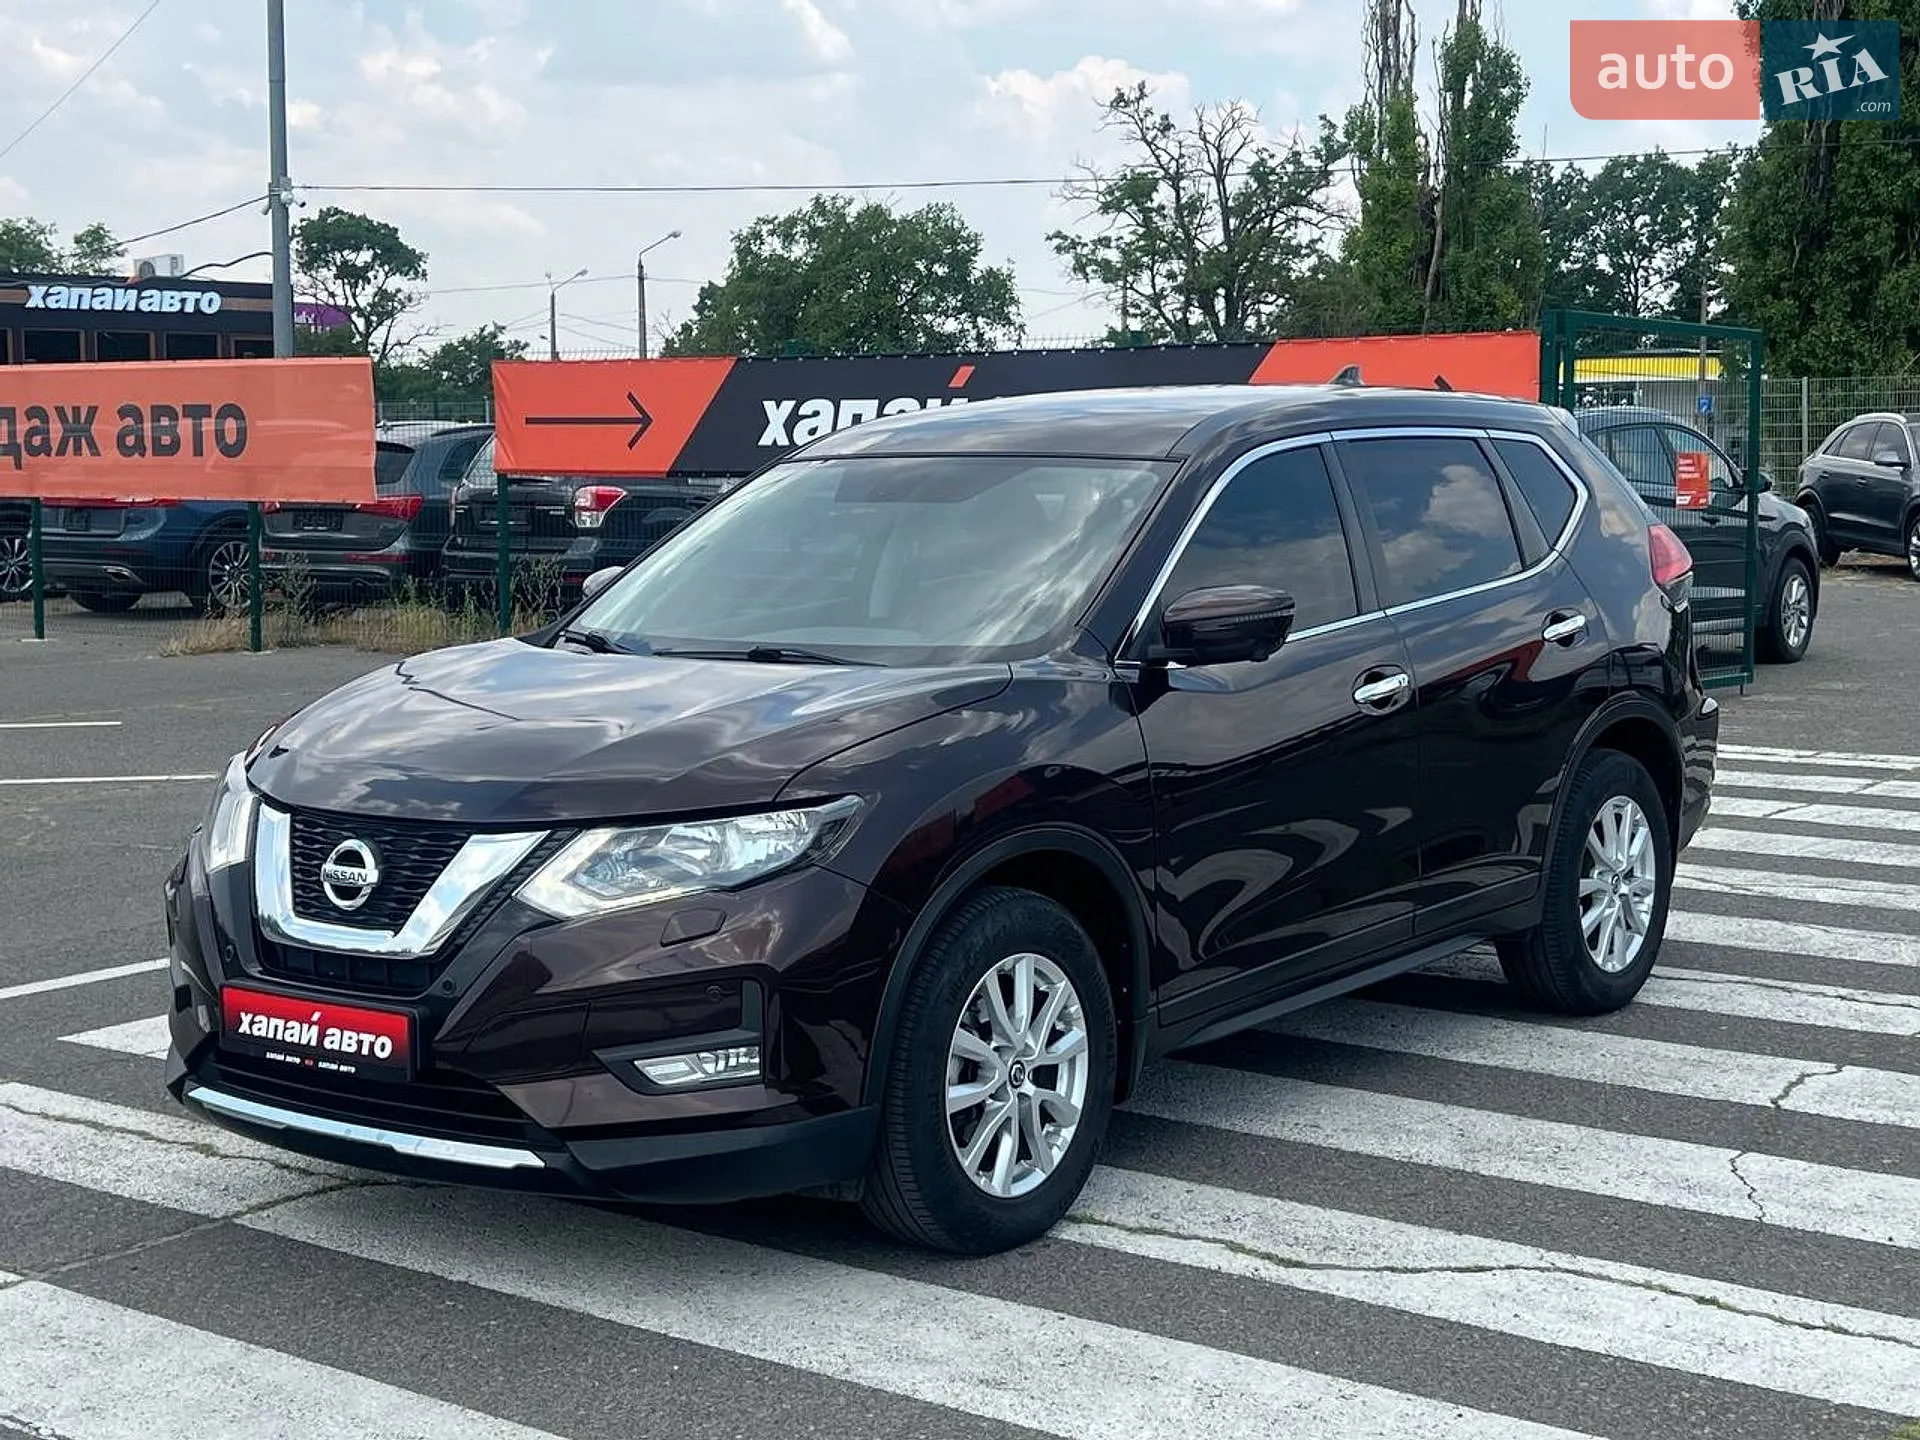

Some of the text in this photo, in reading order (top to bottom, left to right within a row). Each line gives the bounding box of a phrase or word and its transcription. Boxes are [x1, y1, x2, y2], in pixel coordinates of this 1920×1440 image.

[139, 289, 222, 315] авто
[116, 403, 248, 458] авто
[324, 867, 368, 883] NISSAN
[323, 1027, 393, 1059] авто
